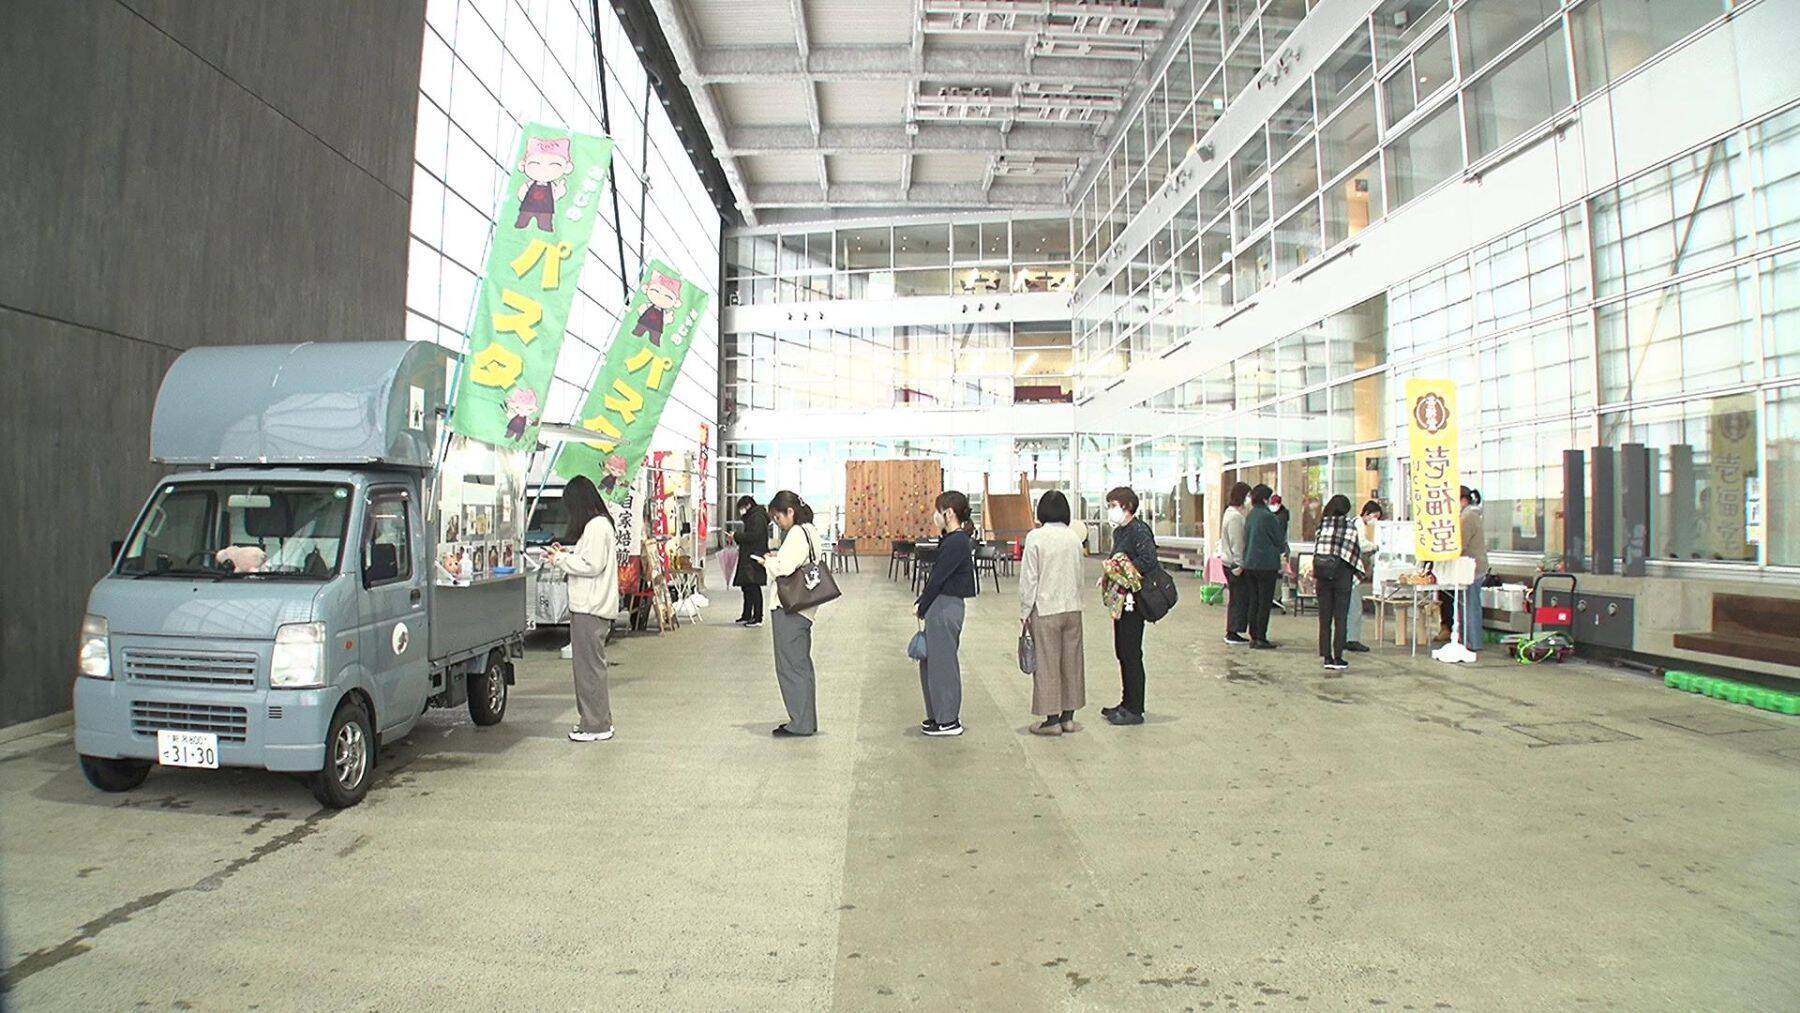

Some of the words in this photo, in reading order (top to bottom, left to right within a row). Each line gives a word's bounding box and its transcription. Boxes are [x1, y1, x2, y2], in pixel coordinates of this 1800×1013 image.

[471, 239, 572, 390] パスタ
[582, 347, 674, 454] パスタ
